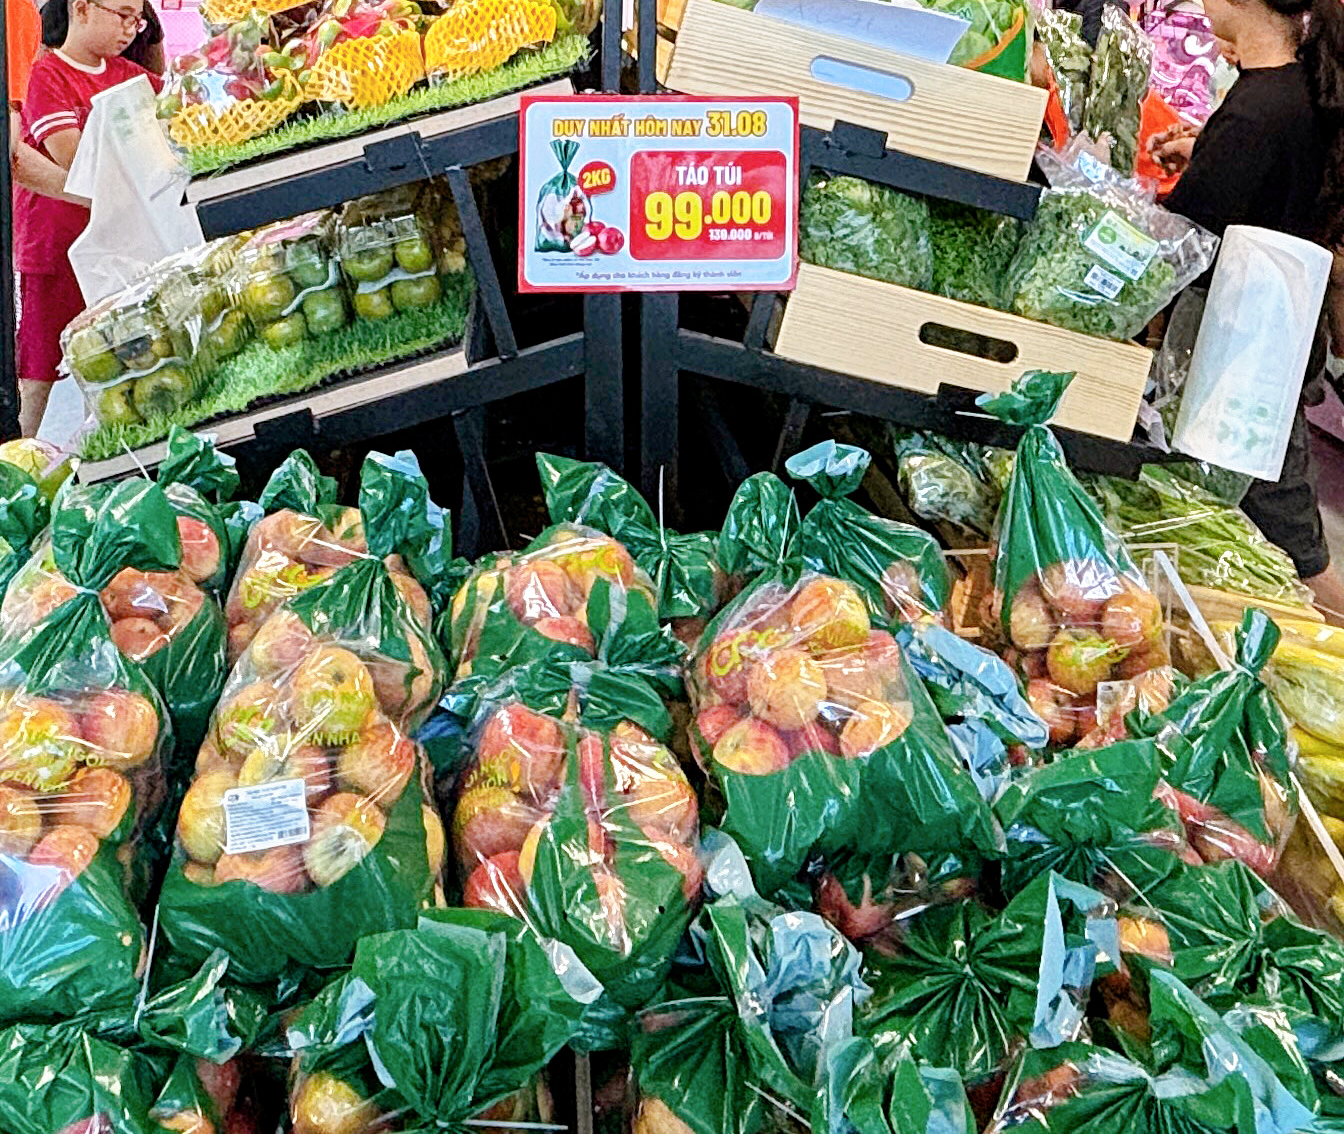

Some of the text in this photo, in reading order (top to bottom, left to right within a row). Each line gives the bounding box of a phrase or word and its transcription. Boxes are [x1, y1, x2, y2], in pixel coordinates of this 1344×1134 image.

[552, 110, 768, 137] DUY NHẤT HÔM NAY 31.08
[581, 168, 612, 189] 2KG
[676, 162, 742, 186] TÁO TÚI
[644, 190, 772, 241] 99.000
